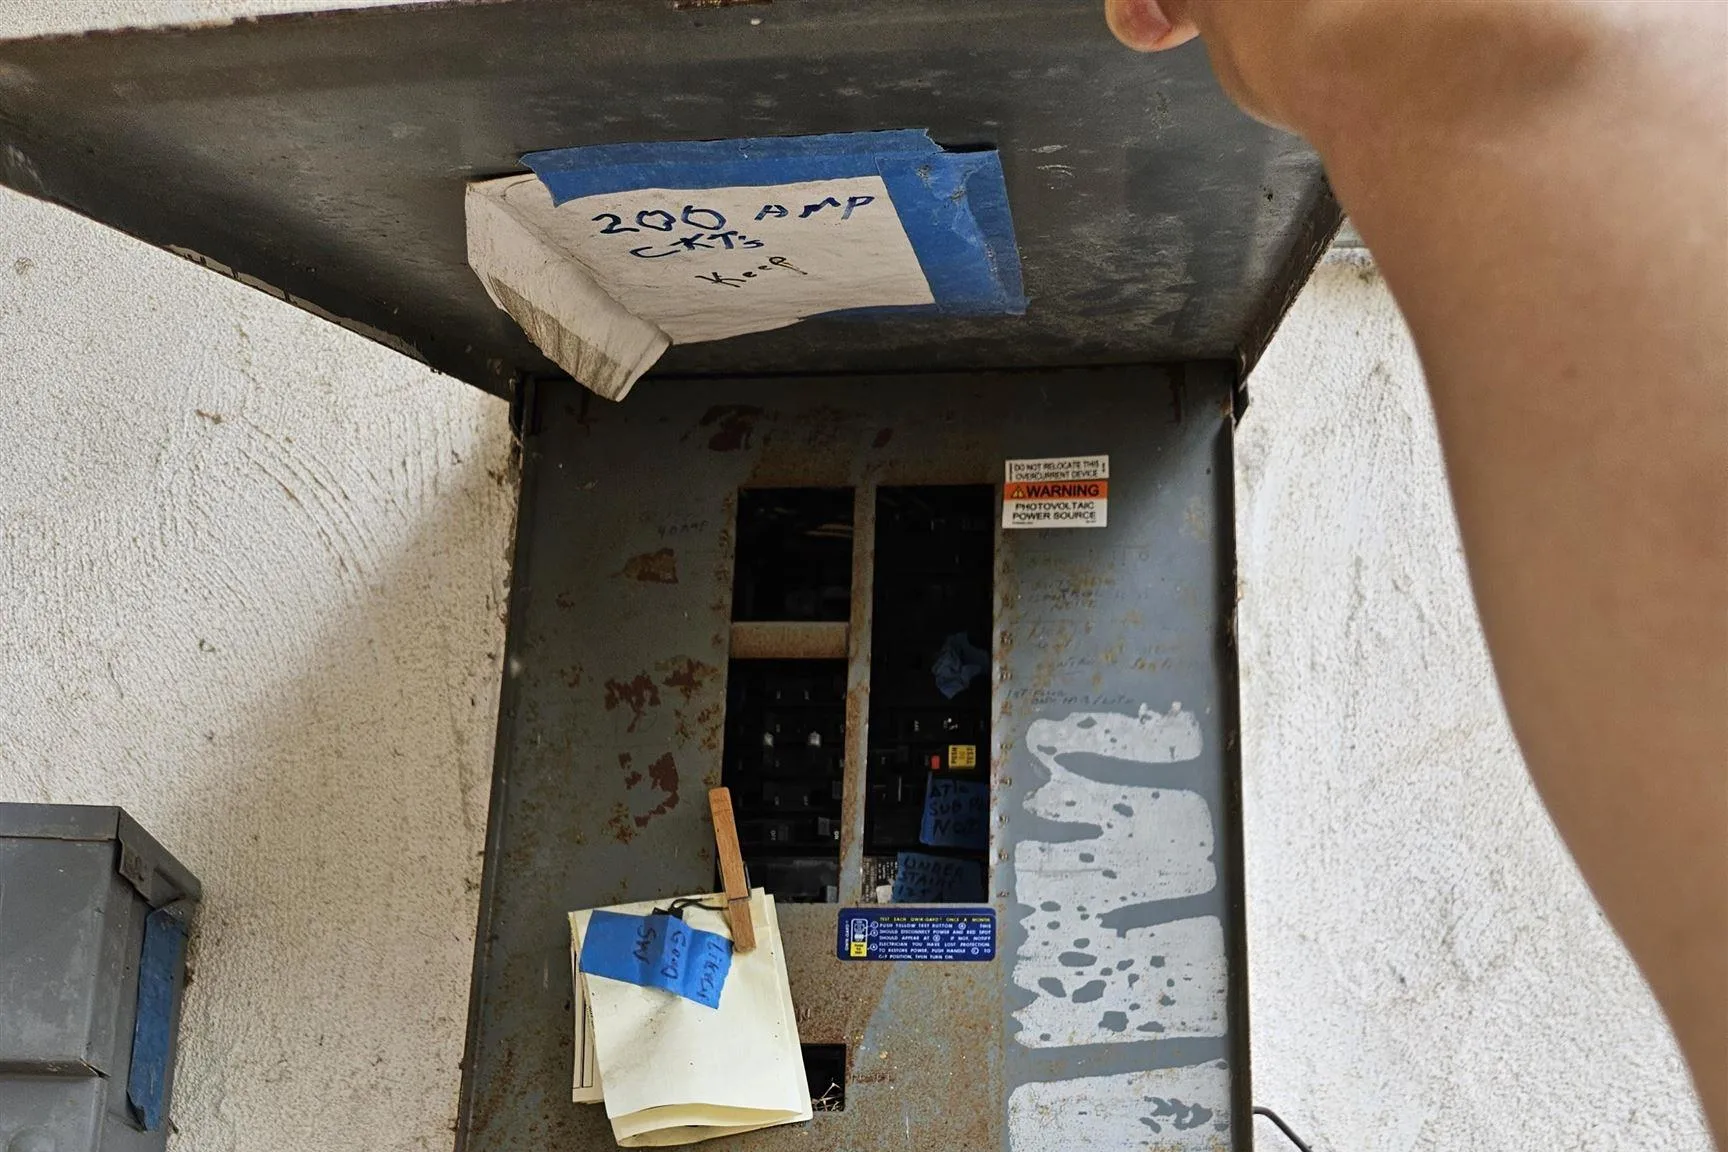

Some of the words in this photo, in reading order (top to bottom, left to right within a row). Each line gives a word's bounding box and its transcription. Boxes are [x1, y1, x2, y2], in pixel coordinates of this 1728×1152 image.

[592, 205, 730, 235] 200
[754, 195, 875, 221] AMP
[1027, 463, 1041, 471] NOT
[1044, 461, 1080, 470] RELOCATE
[1083, 460, 1099, 468] THIS
[1027, 484, 1099, 497] WARNING
[1015, 502, 1094, 510] PHOTOVOLTAIC
[1013, 512, 1050, 520] POWER
[1053, 511, 1096, 520] SOURCE
